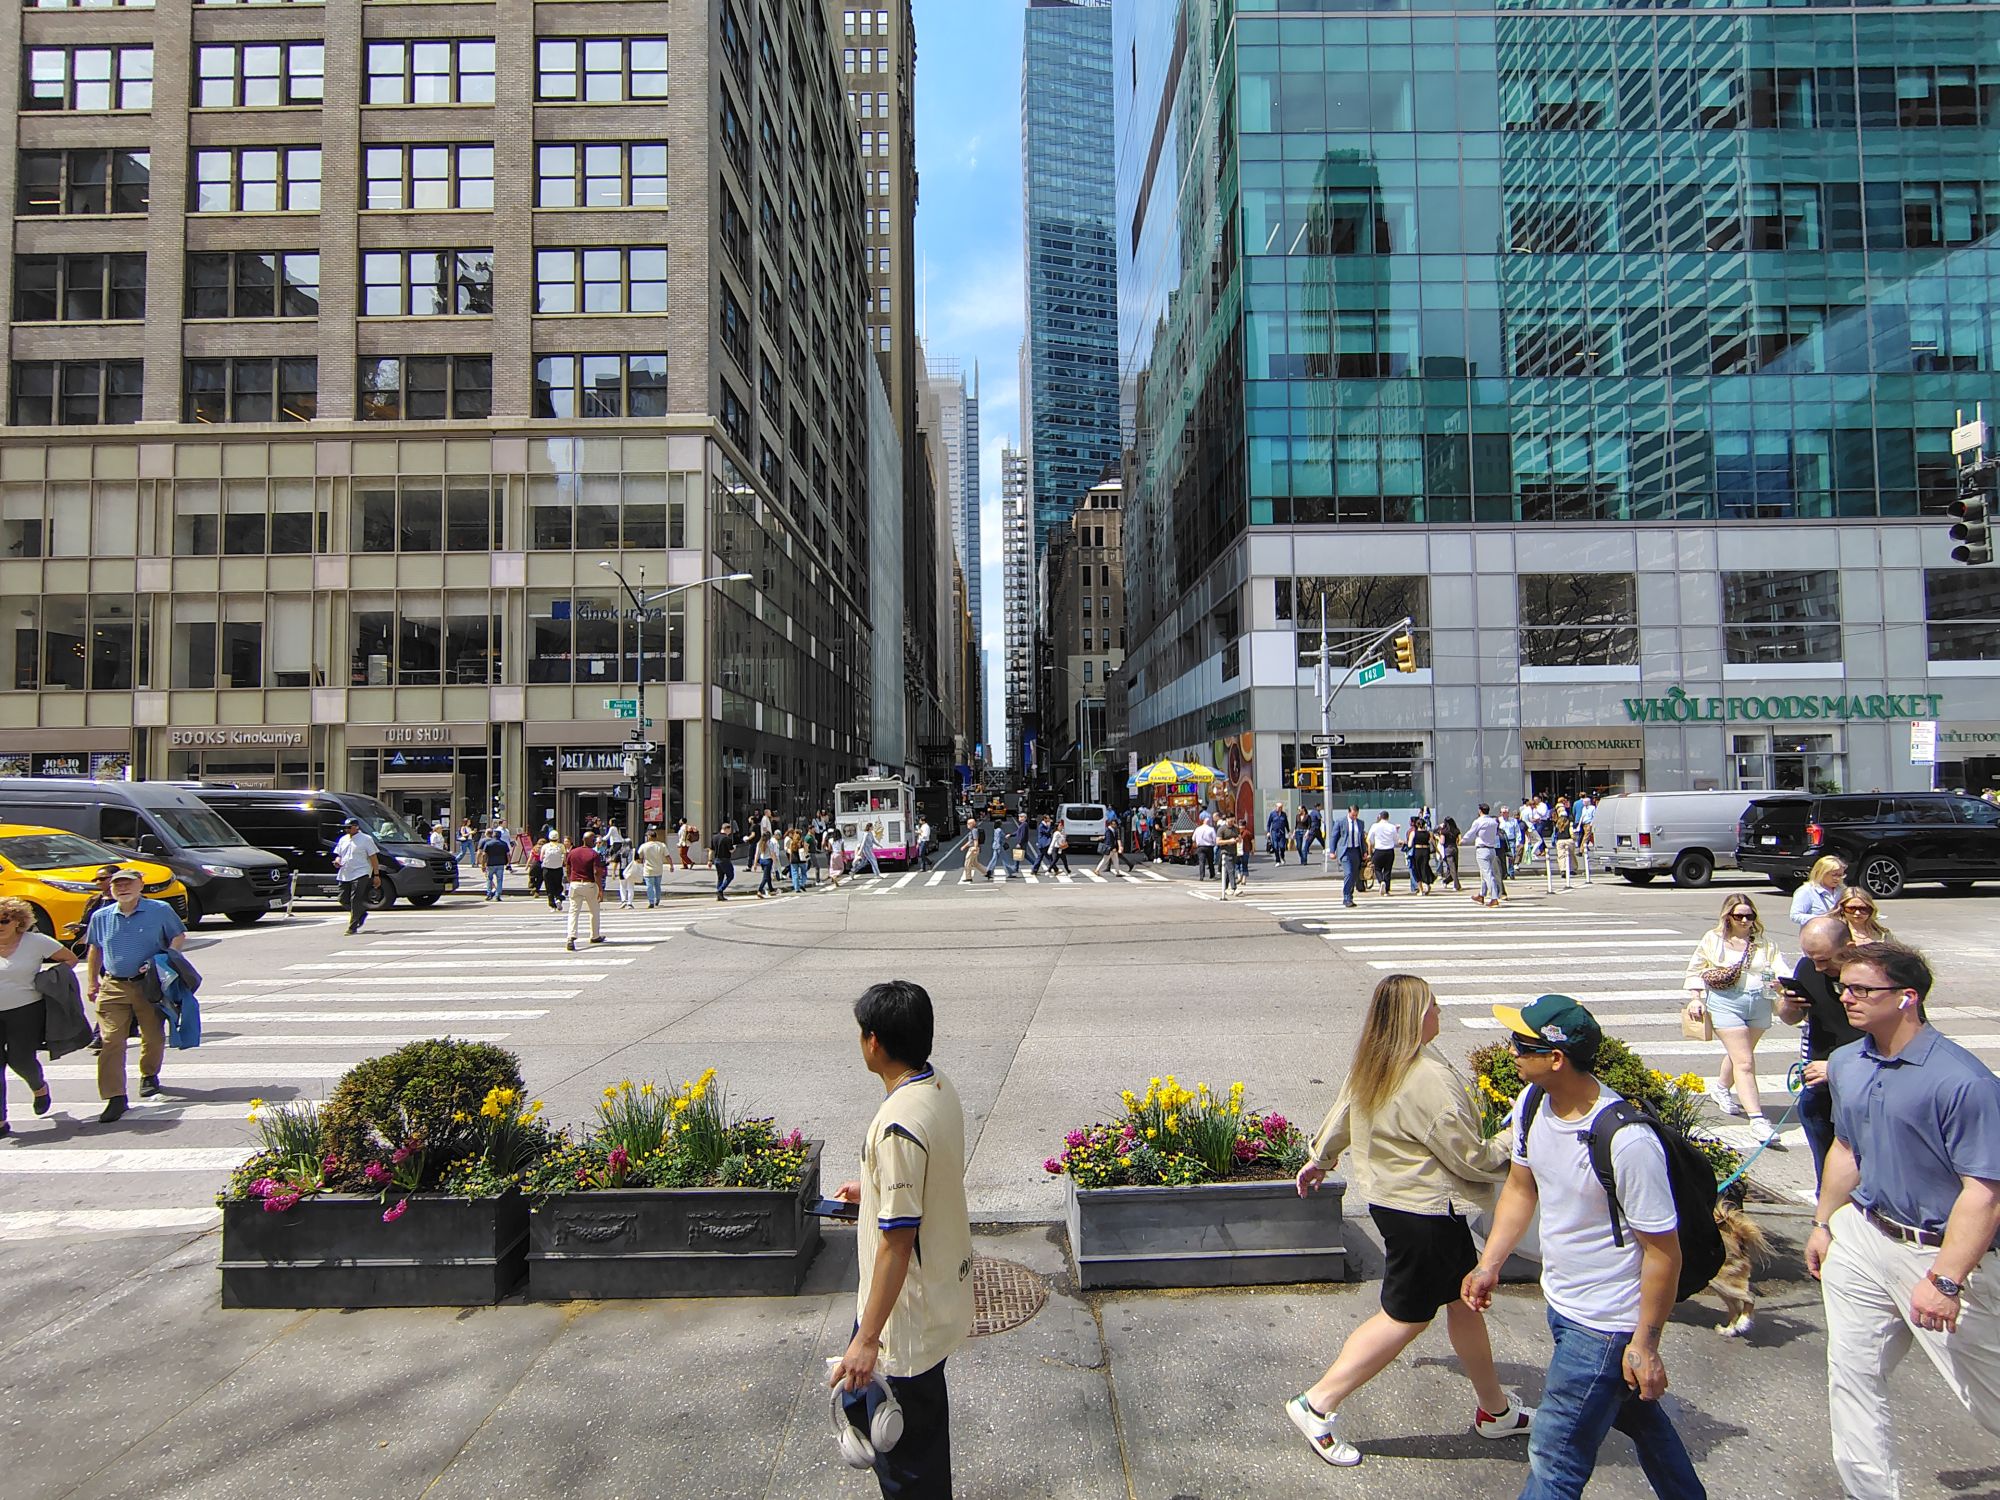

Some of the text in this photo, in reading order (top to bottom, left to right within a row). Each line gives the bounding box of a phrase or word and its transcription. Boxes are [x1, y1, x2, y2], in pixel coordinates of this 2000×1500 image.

[1623, 687, 1943, 722] WHOLE FOODS MARKET
[172, 730, 302, 746] BOOKS Kinokuniya
[383, 728, 450, 742] TOHO SHOJI
[1524, 737, 1641, 750] WHOLE FOODS MARKET
[560, 753, 585, 769] PRET
[587, 753, 594, 768] A
[42, 768, 80, 776] CARAVAN
